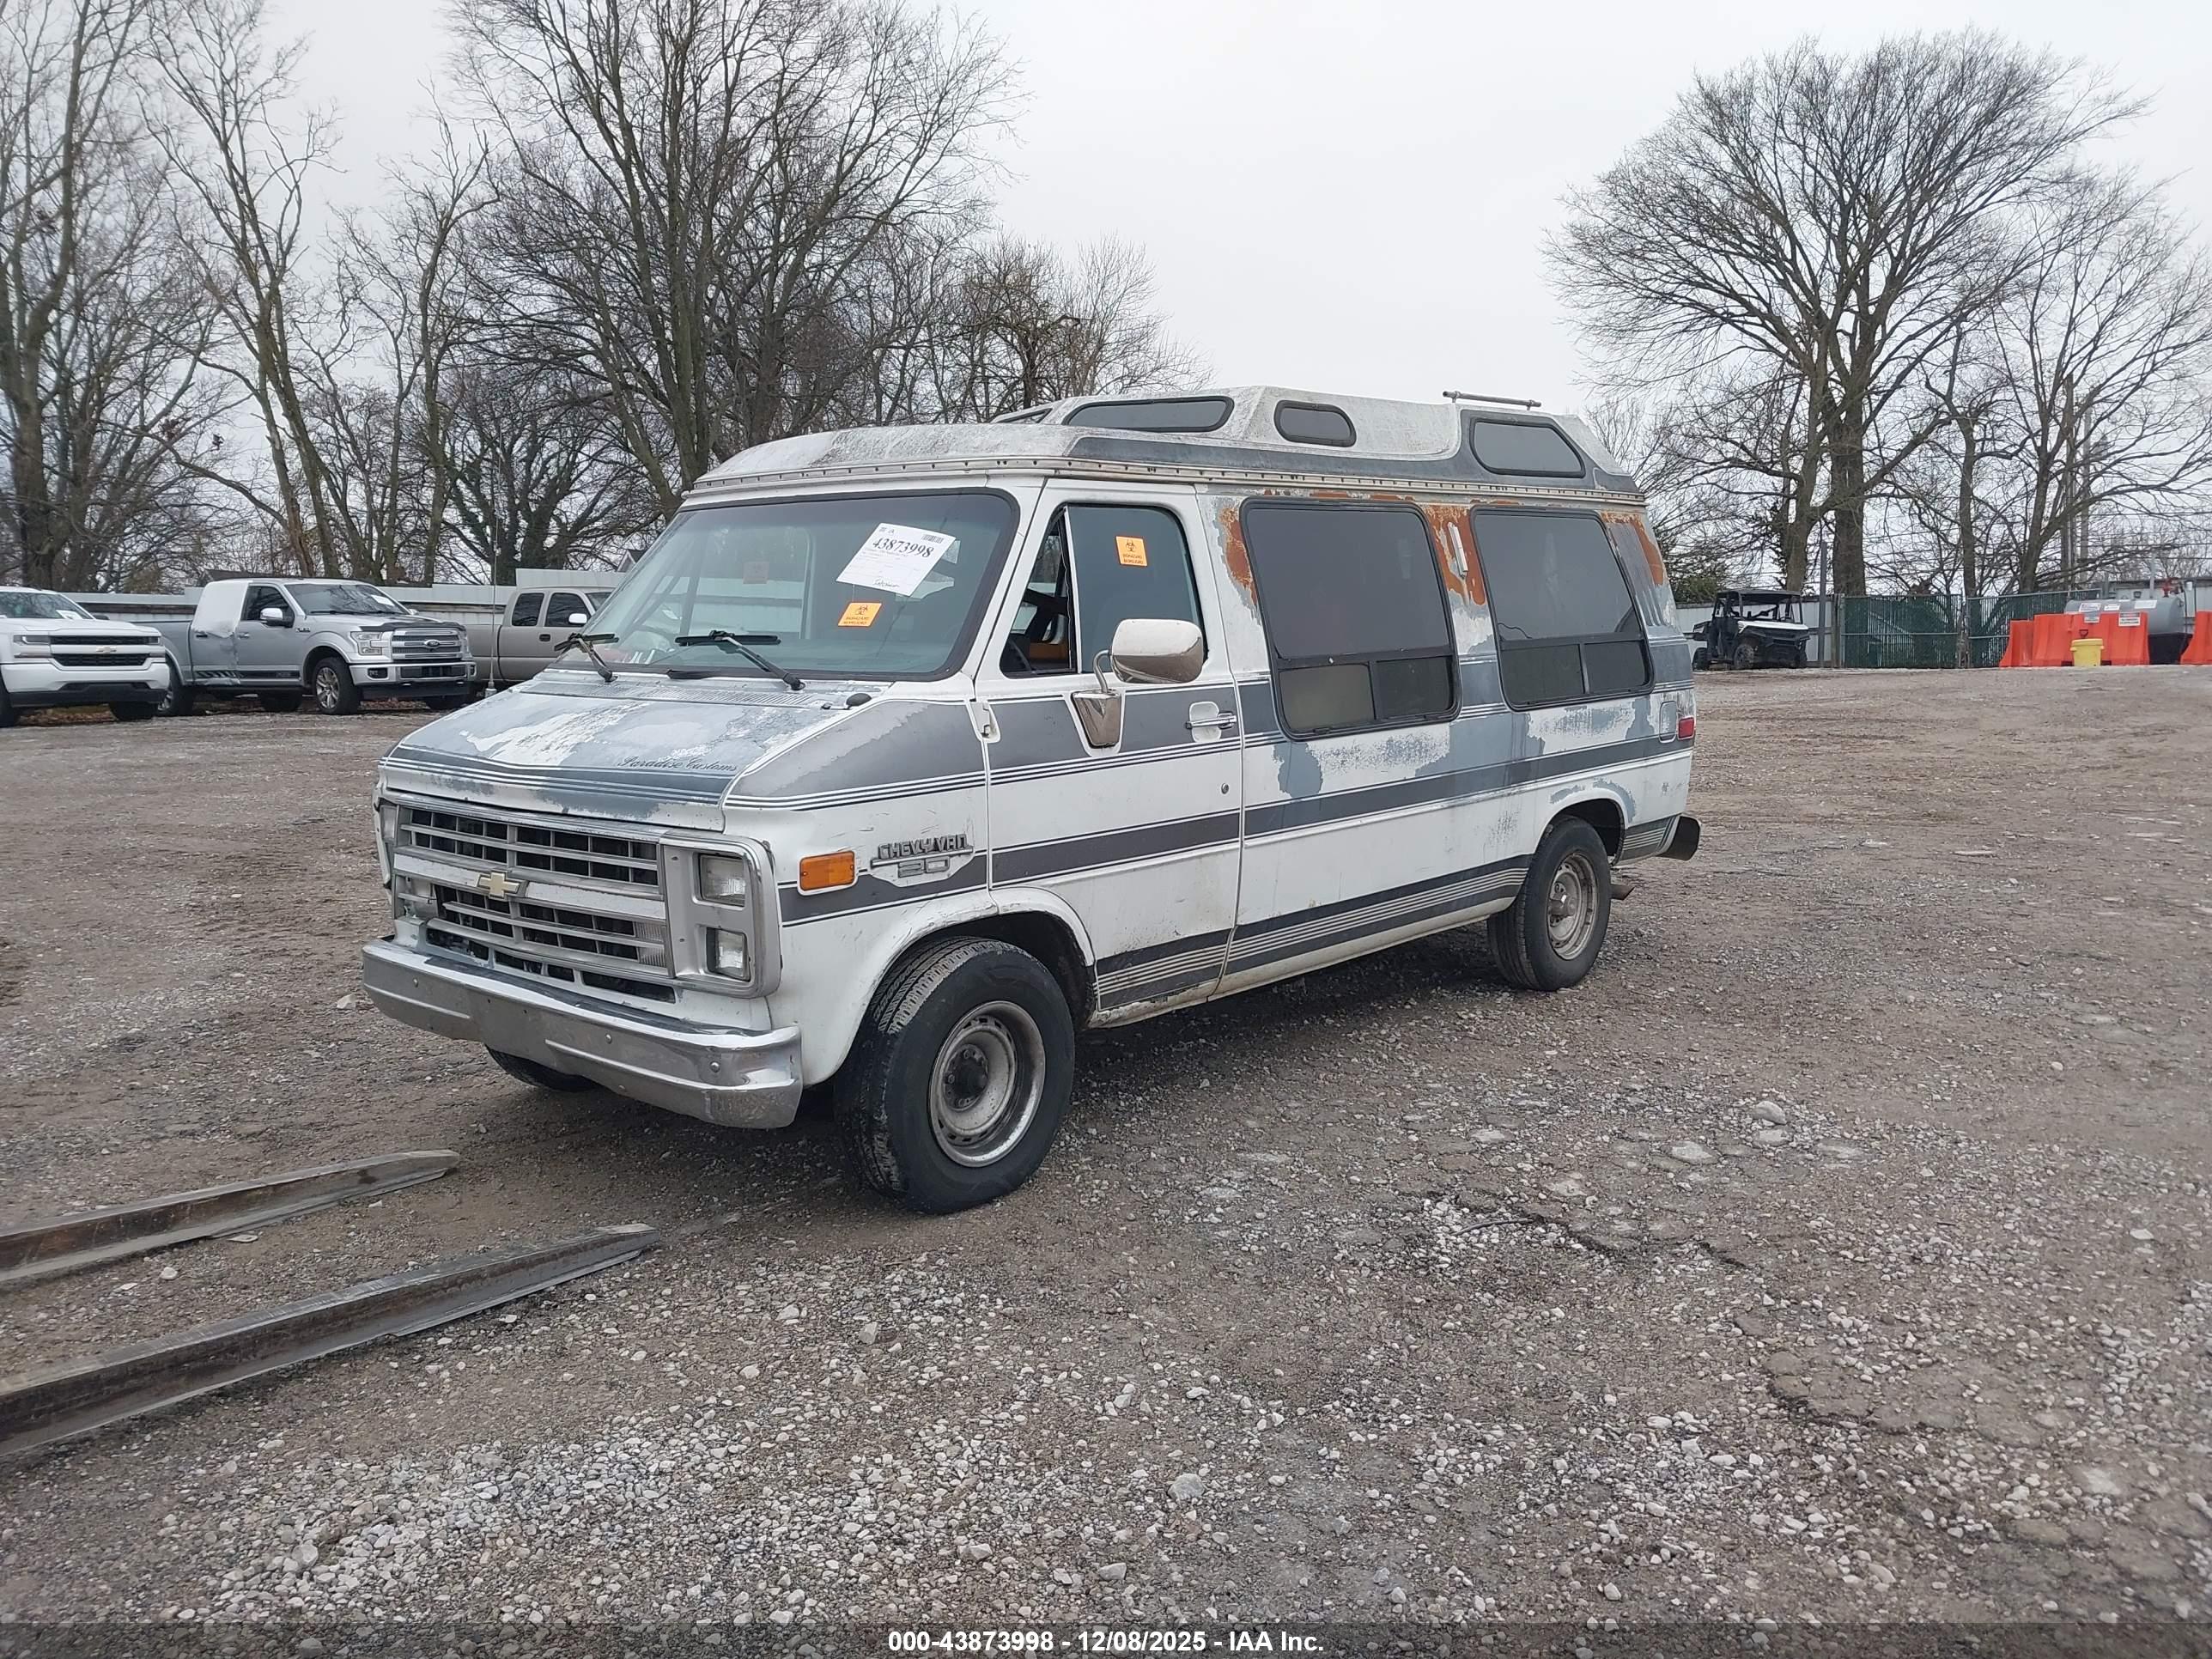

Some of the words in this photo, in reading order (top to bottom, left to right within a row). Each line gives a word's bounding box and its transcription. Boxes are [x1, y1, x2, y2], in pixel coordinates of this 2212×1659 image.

[872, 538, 934, 557] 43873998
[618, 756, 684, 769] Paradise
[686, 757, 737, 772] Customs
[878, 837, 935, 859] CHEVY
[935, 833, 968, 853] VAN
